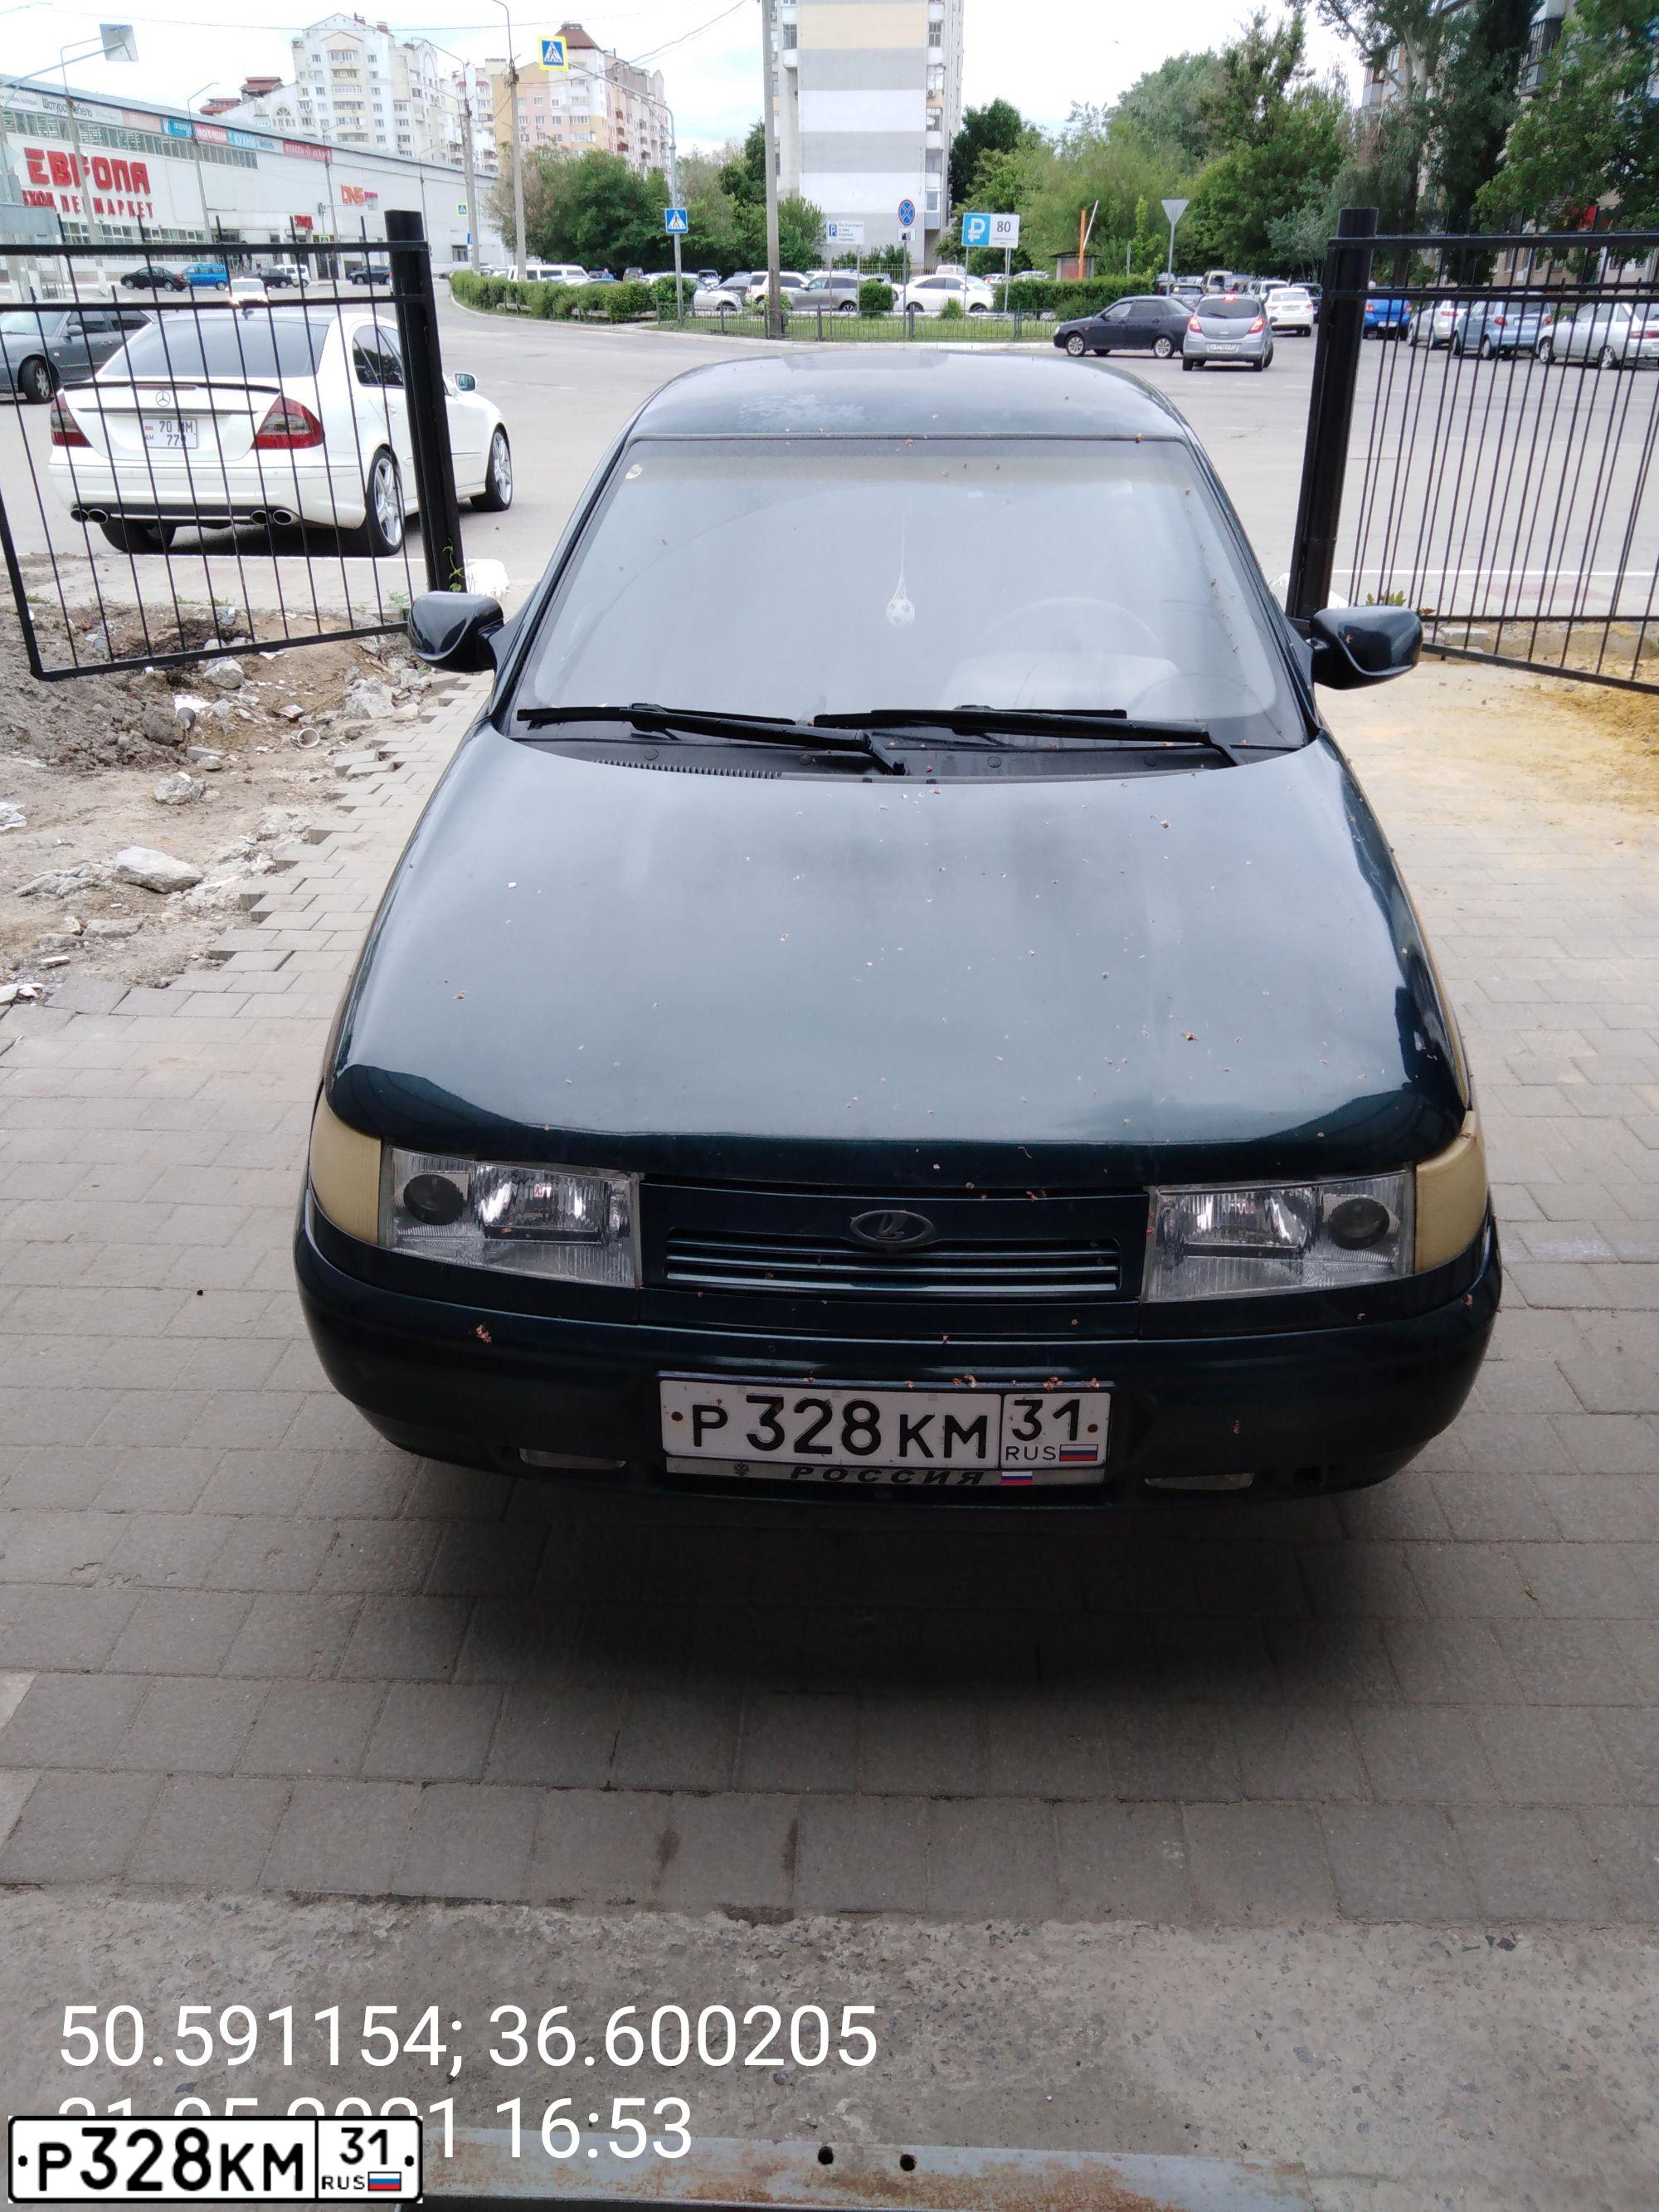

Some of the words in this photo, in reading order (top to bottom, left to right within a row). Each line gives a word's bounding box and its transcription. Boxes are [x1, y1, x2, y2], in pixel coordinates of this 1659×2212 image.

[24, 148, 151, 194] ЕВРОПА
[996, 221, 1011, 233] 80
[159, 421, 172, 432] 70
[167, 434, 186, 446] 77
[1012, 1398, 1082, 1442] 31
[1005, 1445, 1057, 1462] RUS
[790, 1465, 985, 1485] РОССИЯ
